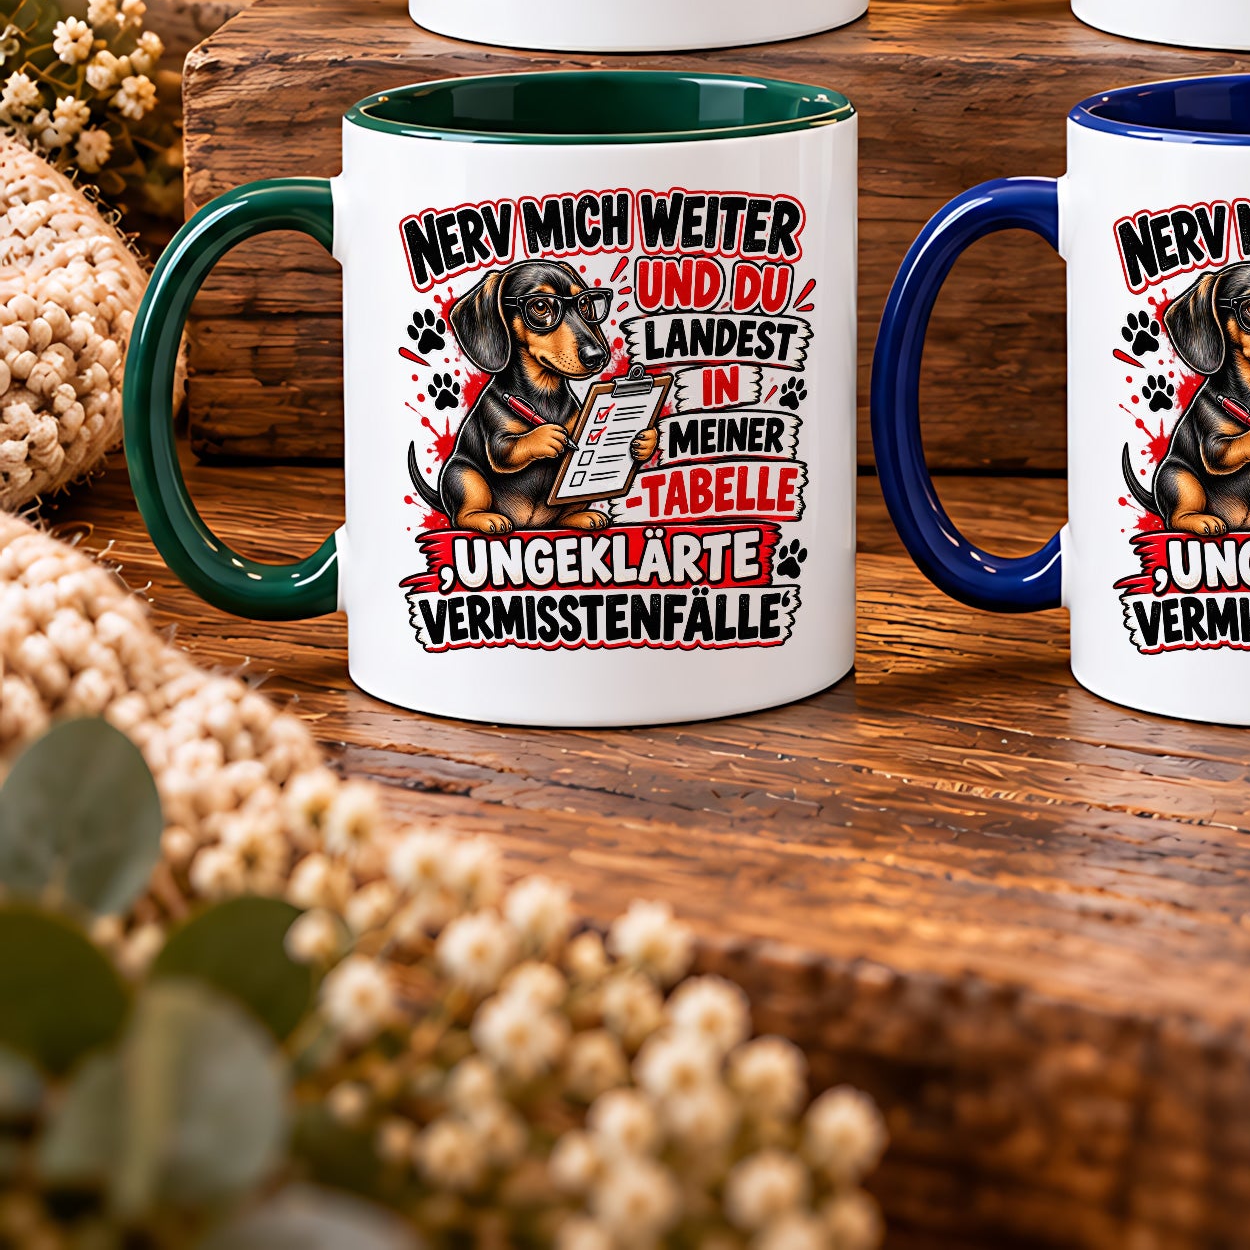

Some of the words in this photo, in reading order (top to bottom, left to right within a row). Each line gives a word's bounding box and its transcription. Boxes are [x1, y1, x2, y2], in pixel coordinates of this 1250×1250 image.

[405, 202, 512, 284] NERV
[522, 194, 629, 253] MICH
[640, 193, 802, 254] WEITER
[1119, 204, 1226, 285] NERV
[638, 259, 721, 308] UND
[733, 263, 790, 309] DU
[645, 320, 798, 359] LANDEST
[702, 368, 739, 406] IN
[671, 418, 783, 456] MEINER
